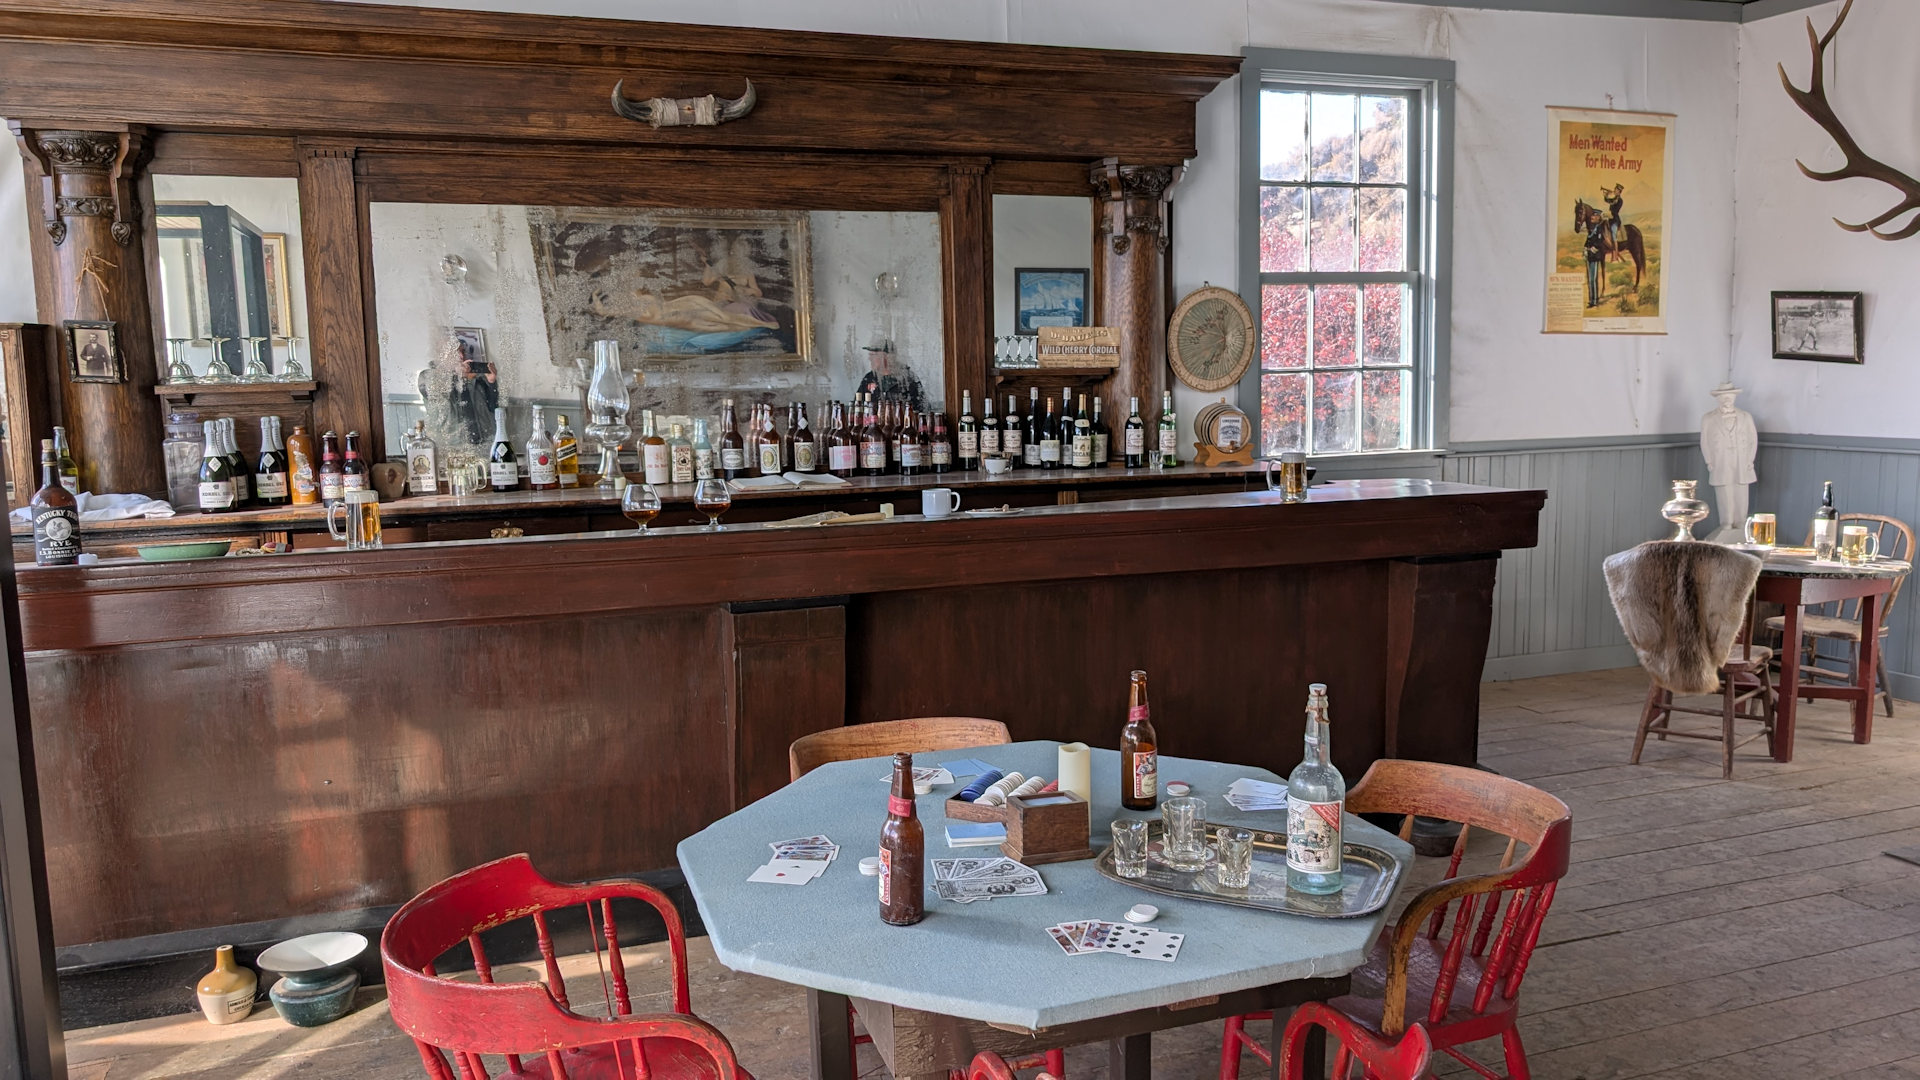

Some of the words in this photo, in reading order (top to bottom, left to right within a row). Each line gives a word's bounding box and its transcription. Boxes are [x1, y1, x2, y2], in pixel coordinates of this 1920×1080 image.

[1569, 134, 1590, 150] Men
[1591, 134, 1628, 152] Wanted
[1585, 153, 1599, 168] for
[1600, 154, 1616, 169] the
[1617, 155, 1643, 173] Army
[36, 510, 65, 525] KENTUCKY
